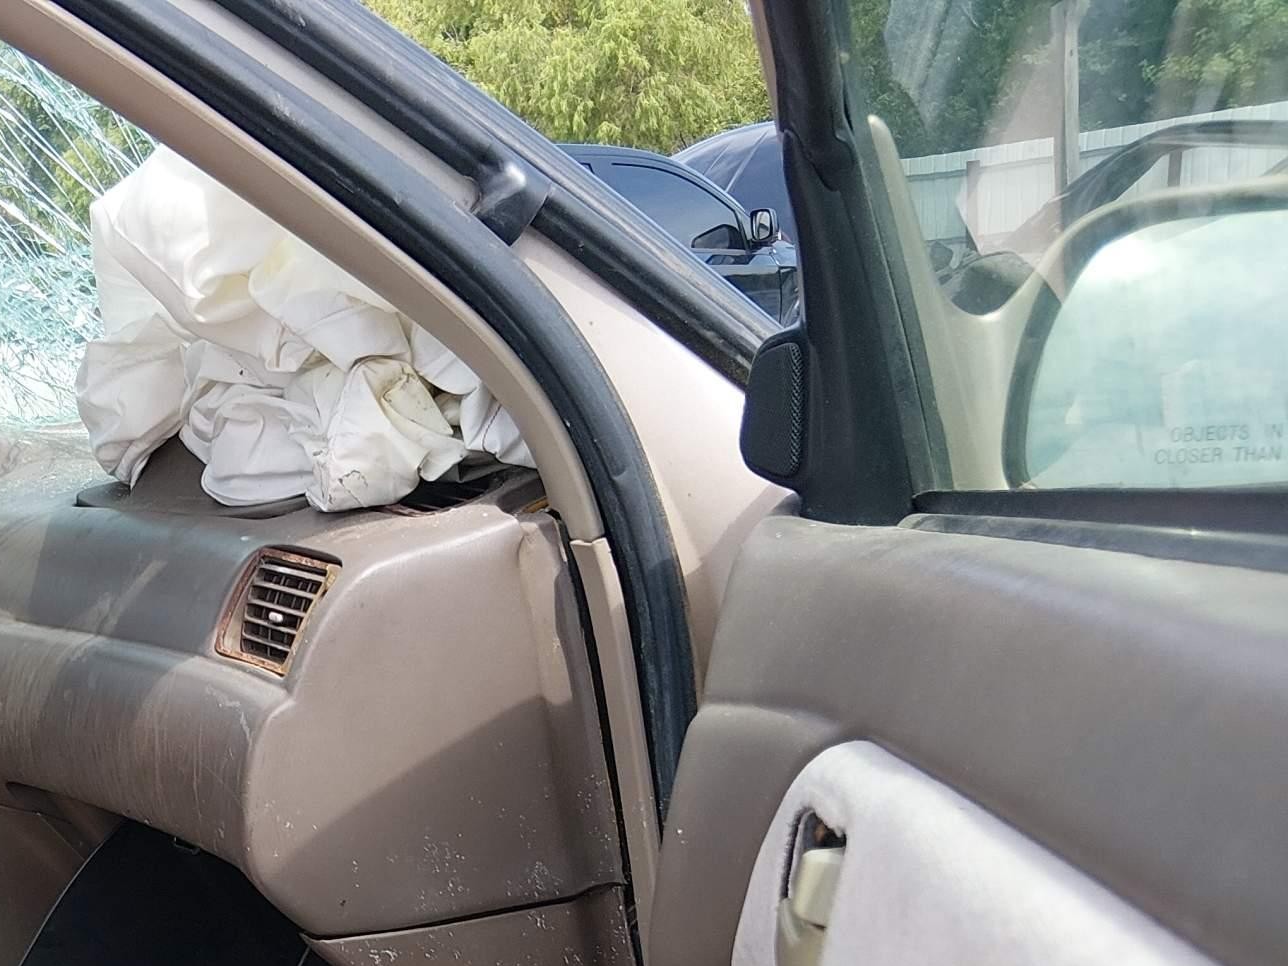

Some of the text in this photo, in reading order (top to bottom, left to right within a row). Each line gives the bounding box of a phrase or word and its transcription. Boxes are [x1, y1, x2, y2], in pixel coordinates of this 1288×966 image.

[1171, 425, 1250, 442] OBJECTS
[1154, 446, 1282, 464] CLOSER THAN
